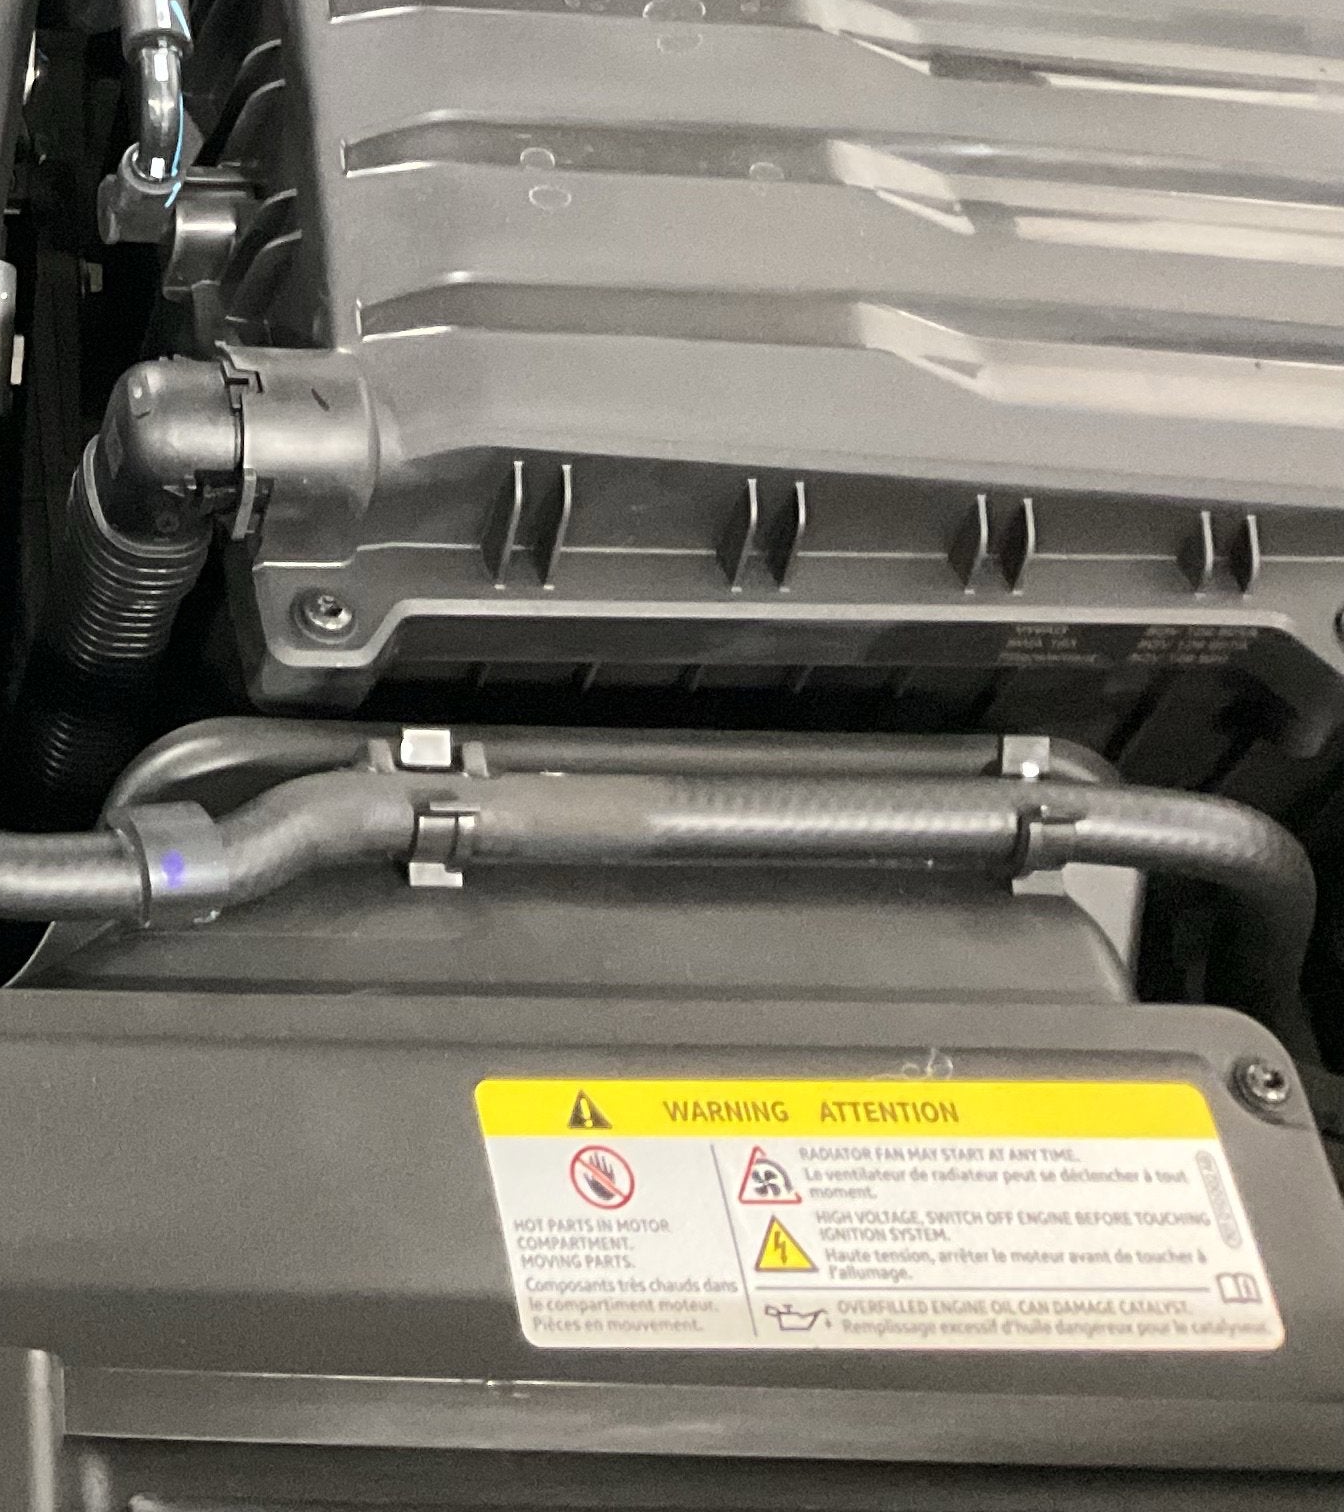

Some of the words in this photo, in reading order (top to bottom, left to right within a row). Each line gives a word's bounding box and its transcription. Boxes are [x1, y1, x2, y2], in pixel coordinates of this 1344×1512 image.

[662, 1101, 789, 1122] WARNING
[820, 1101, 959, 1123] ATTENTION
[800, 1148, 872, 1161] RADIATOR
[875, 1148, 905, 1161] FAN
[908, 1148, 937, 1161] MAY
[941, 1148, 985, 1161] START
[989, 1148, 1005, 1161] AT
[1009, 1148, 1037, 1161] ANY
[1041, 1148, 1080, 1162] TIME.
[804, 1168, 822, 1181] Le
[826, 1168, 906, 1181] ventilateur
[910, 1169, 928, 1181] de
[932, 1169, 998, 1182] radiateur
[1003, 1170, 1038, 1184] peut
[1040, 1171, 1057, 1182] se
[1061, 1168, 1140, 1182] déclencher
[1144, 1169, 1152, 1182] à
[1155, 1170, 1187, 1183] tout
[810, 1188, 877, 1199] moment.
[513, 1219, 542, 1232] HOT
[548, 1219, 594, 1232] PARTS
[597, 1219, 612, 1232] IN
[617, 1219, 670, 1232] MOTOR
[816, 1211, 852, 1224] HIGH
[926, 1211, 982, 1224] SWITCH
[986, 1211, 1013, 1224] OFF
[1017, 1212, 1072, 1225] ENGINE
[1075, 1212, 1132, 1225] BEFORE
[1136, 1212, 1211, 1226] TOUCHING
[820, 1228, 886, 1240] IGNITION
[889, 1228, 951, 1241] SYSTEM.
[518, 1237, 634, 1250] COMPARTMENT.
[521, 1255, 582, 1268] MOVING
[585, 1255, 635, 1268] PARTS.
[825, 1249, 871, 1262] Haute
[874, 1249, 935, 1265] tension,
[939, 1249, 988, 1263] arrêter
[993, 1250, 1006, 1263] le
[1011, 1251, 1064, 1263] moteur
[1069, 1250, 1110, 1263] avant
[1115, 1249, 1132, 1263] de
[1136, 1249, 1192, 1263] toucher
[1197, 1250, 1207, 1263] à
[525, 1278, 614, 1294] Composants
[618, 1278, 644, 1292] très
[649, 1278, 700, 1292] chauds
[703, 1278, 738, 1293] dans
[529, 1298, 543, 1311] le
[546, 1299, 653, 1314] compartiment
[837, 1300, 928, 1314] OVERFILLED
[932, 1301, 988, 1314] ENGINE
[992, 1301, 1013, 1315] OIL
[1019, 1301, 1049, 1315] CAN
[1053, 1301, 1116, 1315] DAMAGE
[533, 1318, 582, 1332] Pièces
[585, 1320, 603, 1332] en
[608, 1320, 702, 1332] mouvement.
[842, 1320, 935, 1336] Remplissage
